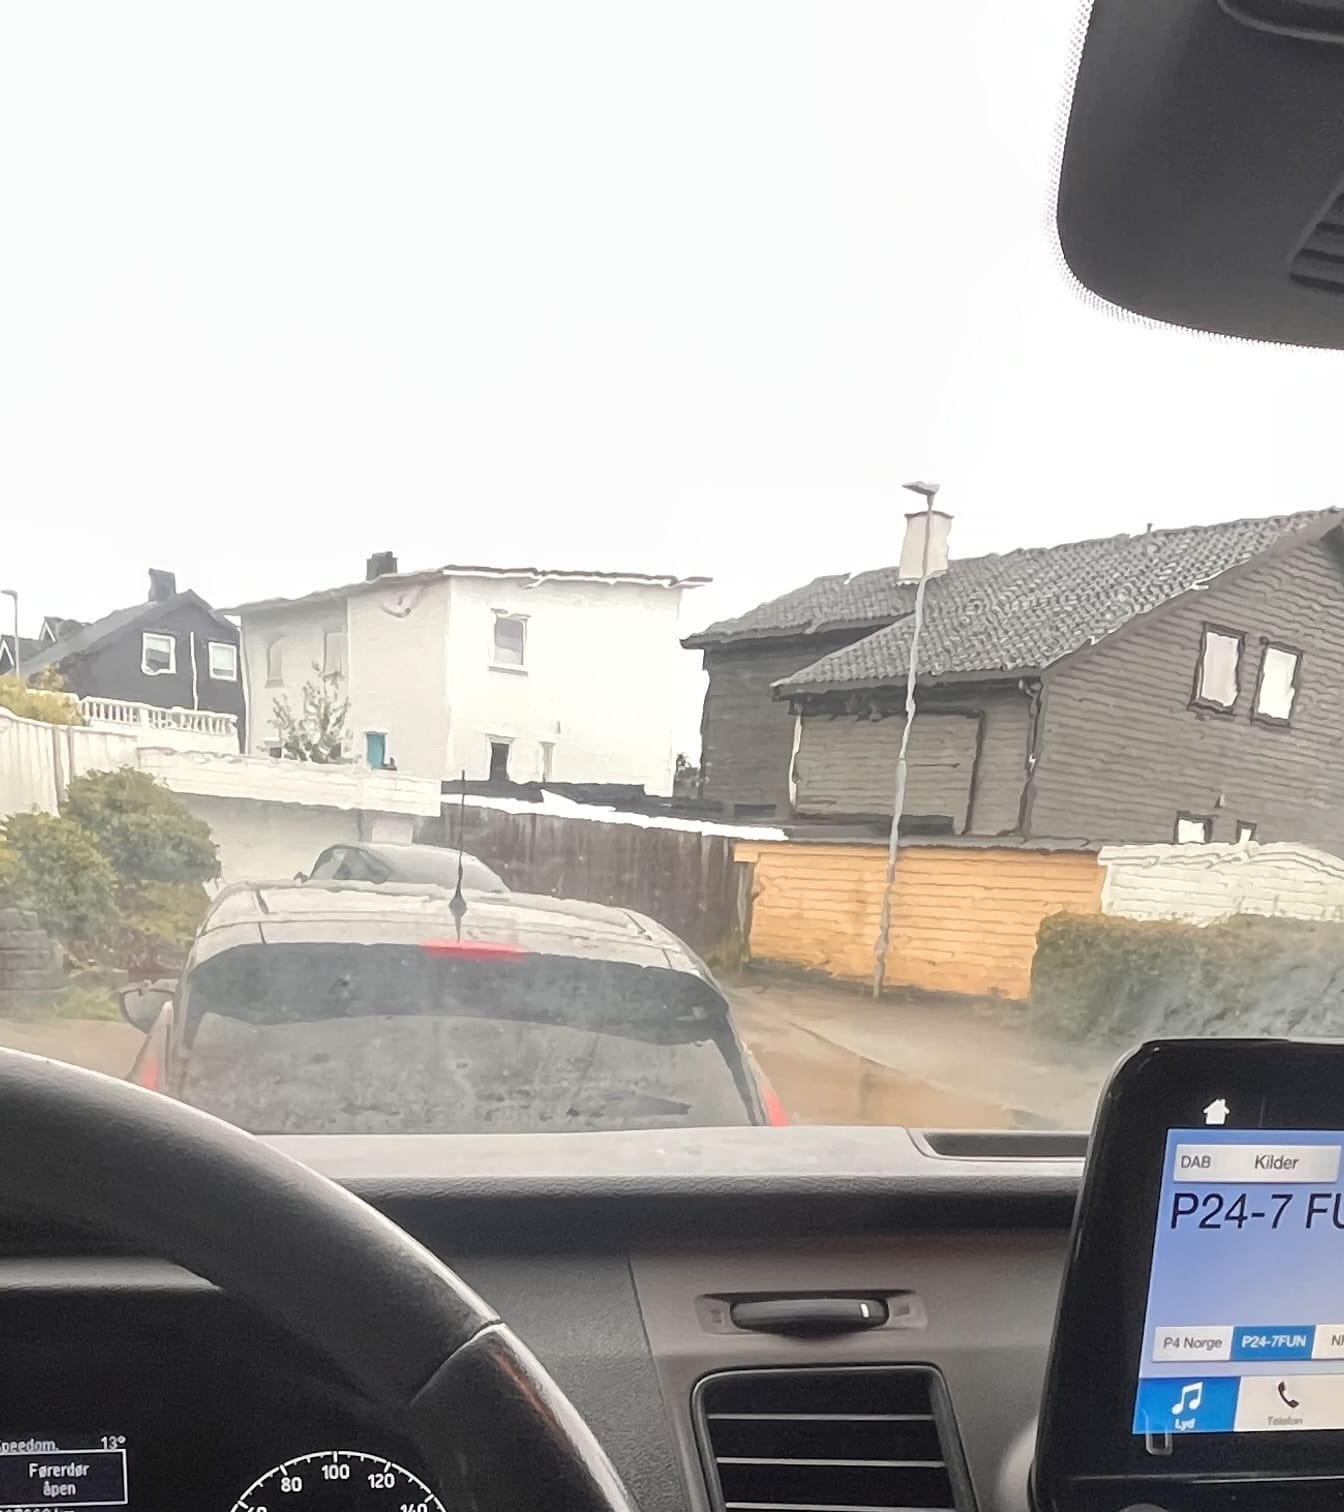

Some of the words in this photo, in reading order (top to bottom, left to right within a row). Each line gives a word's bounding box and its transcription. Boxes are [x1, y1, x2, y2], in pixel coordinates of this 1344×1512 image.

[1180, 1155, 1211, 1169] DAB
[1254, 1154, 1299, 1170] Kilder
[1170, 1192, 1293, 1229] P24-7
[1163, 1337, 1182, 1349] P4
[1183, 1336, 1223, 1351] Norge
[1241, 1335, 1306, 1348] P24-7FUN
[1174, 1418, 1196, 1431] Lyd
[29, 1462, 90, 1478] Førerdør
[321, 1464, 350, 1480] 100
[43, 1481, 76, 1497] åpen
[280, 1476, 303, 1493] 80
[367, 1473, 396, 1489] 120
